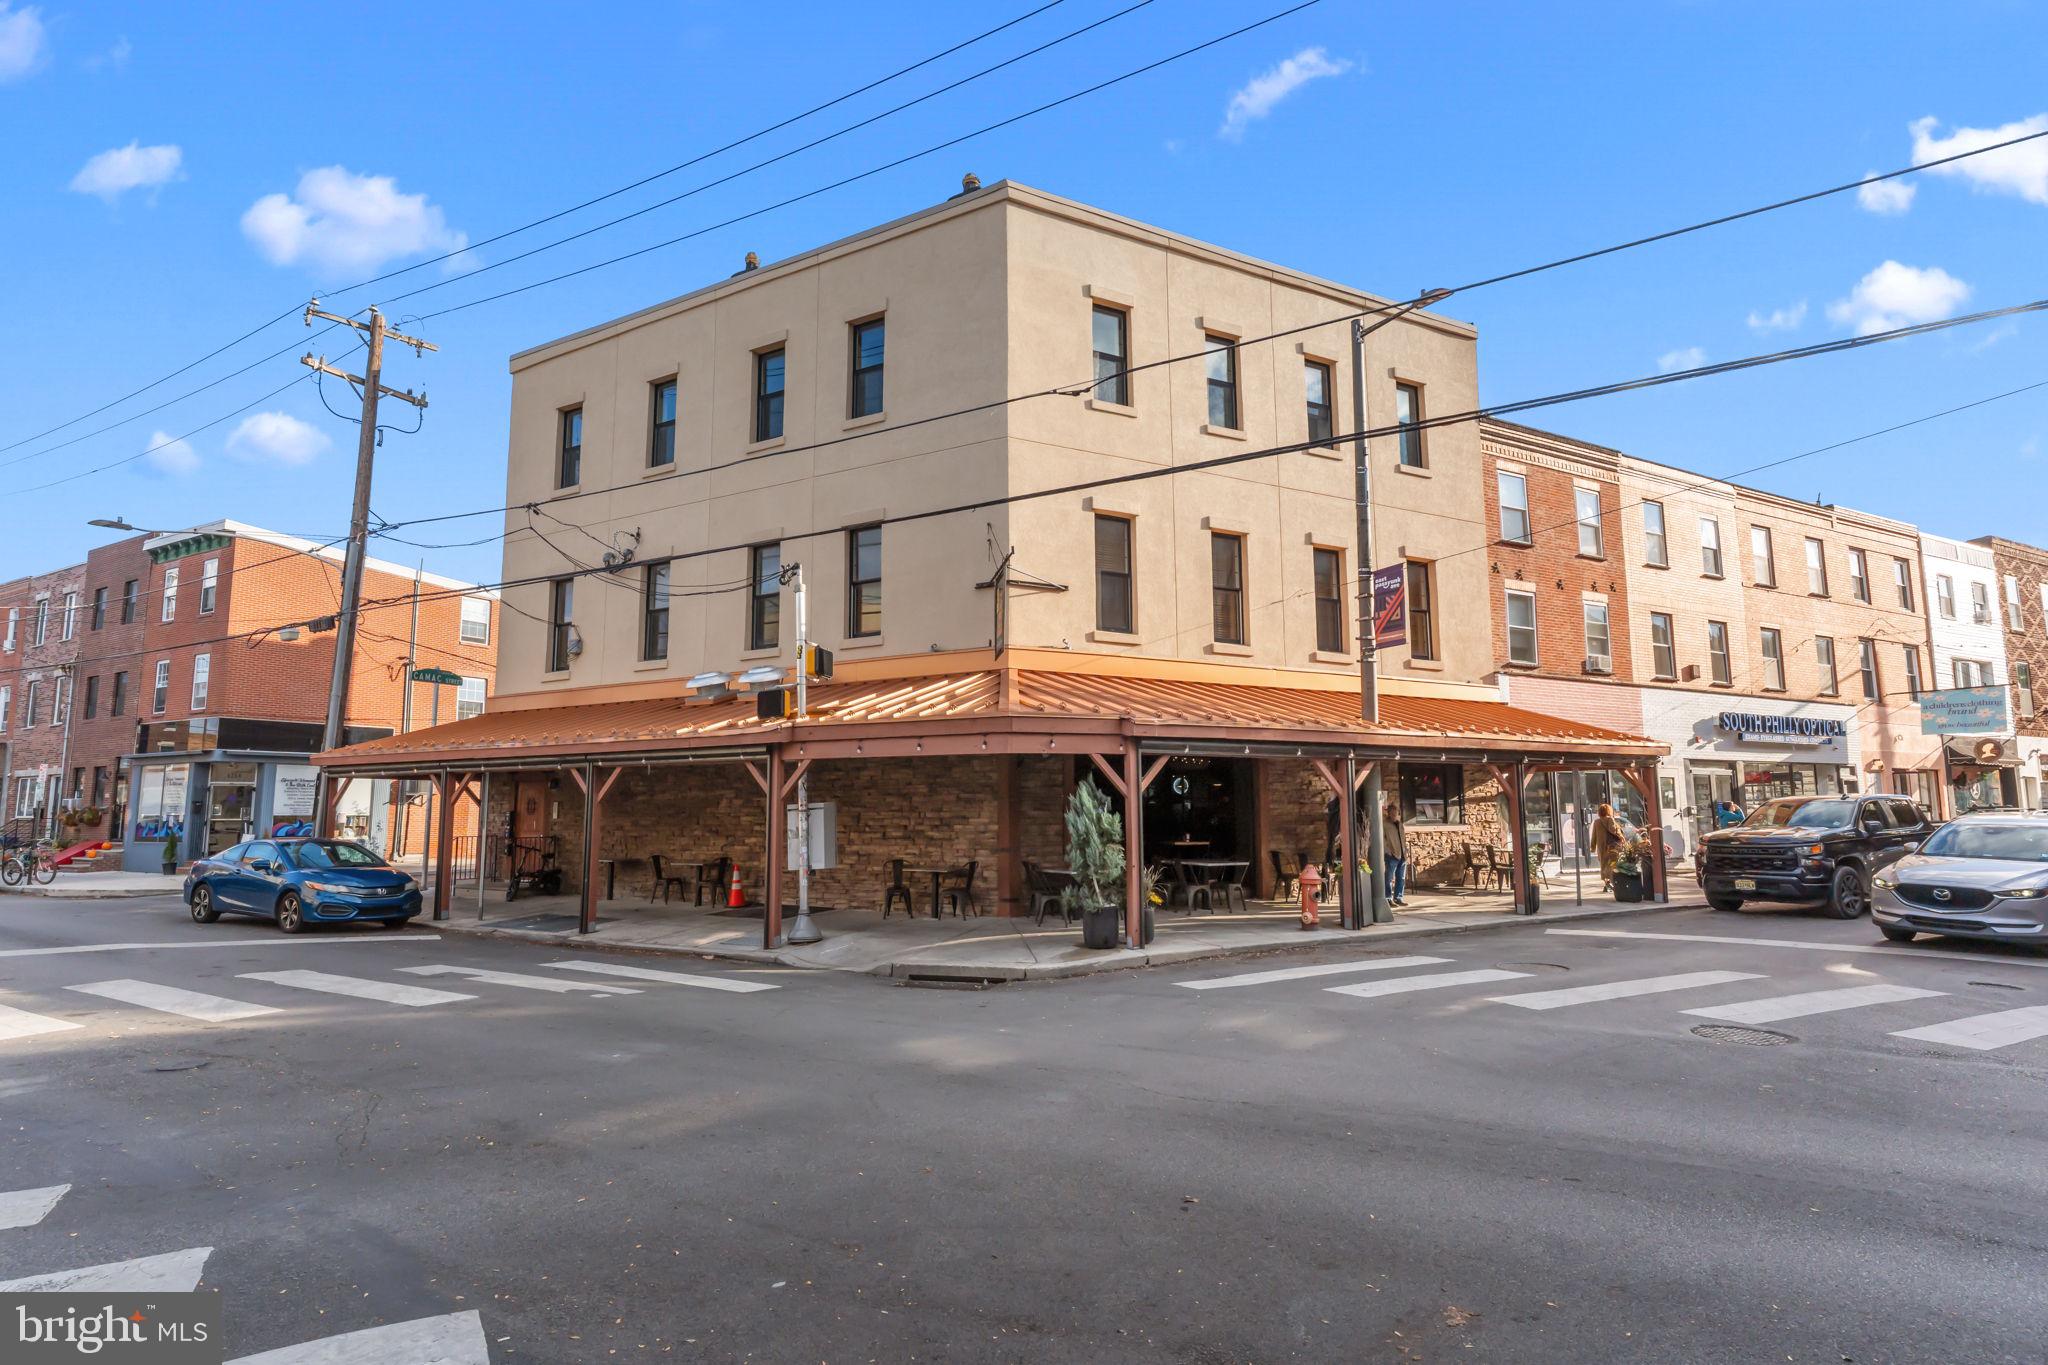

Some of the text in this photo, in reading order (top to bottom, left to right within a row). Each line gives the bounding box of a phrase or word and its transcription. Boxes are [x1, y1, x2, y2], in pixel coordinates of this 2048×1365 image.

[1375, 576, 1387, 584] east
[413, 671, 442, 683] CAMAC
[1723, 712, 1847, 737] SOUTH PHILLY OPTICAL
